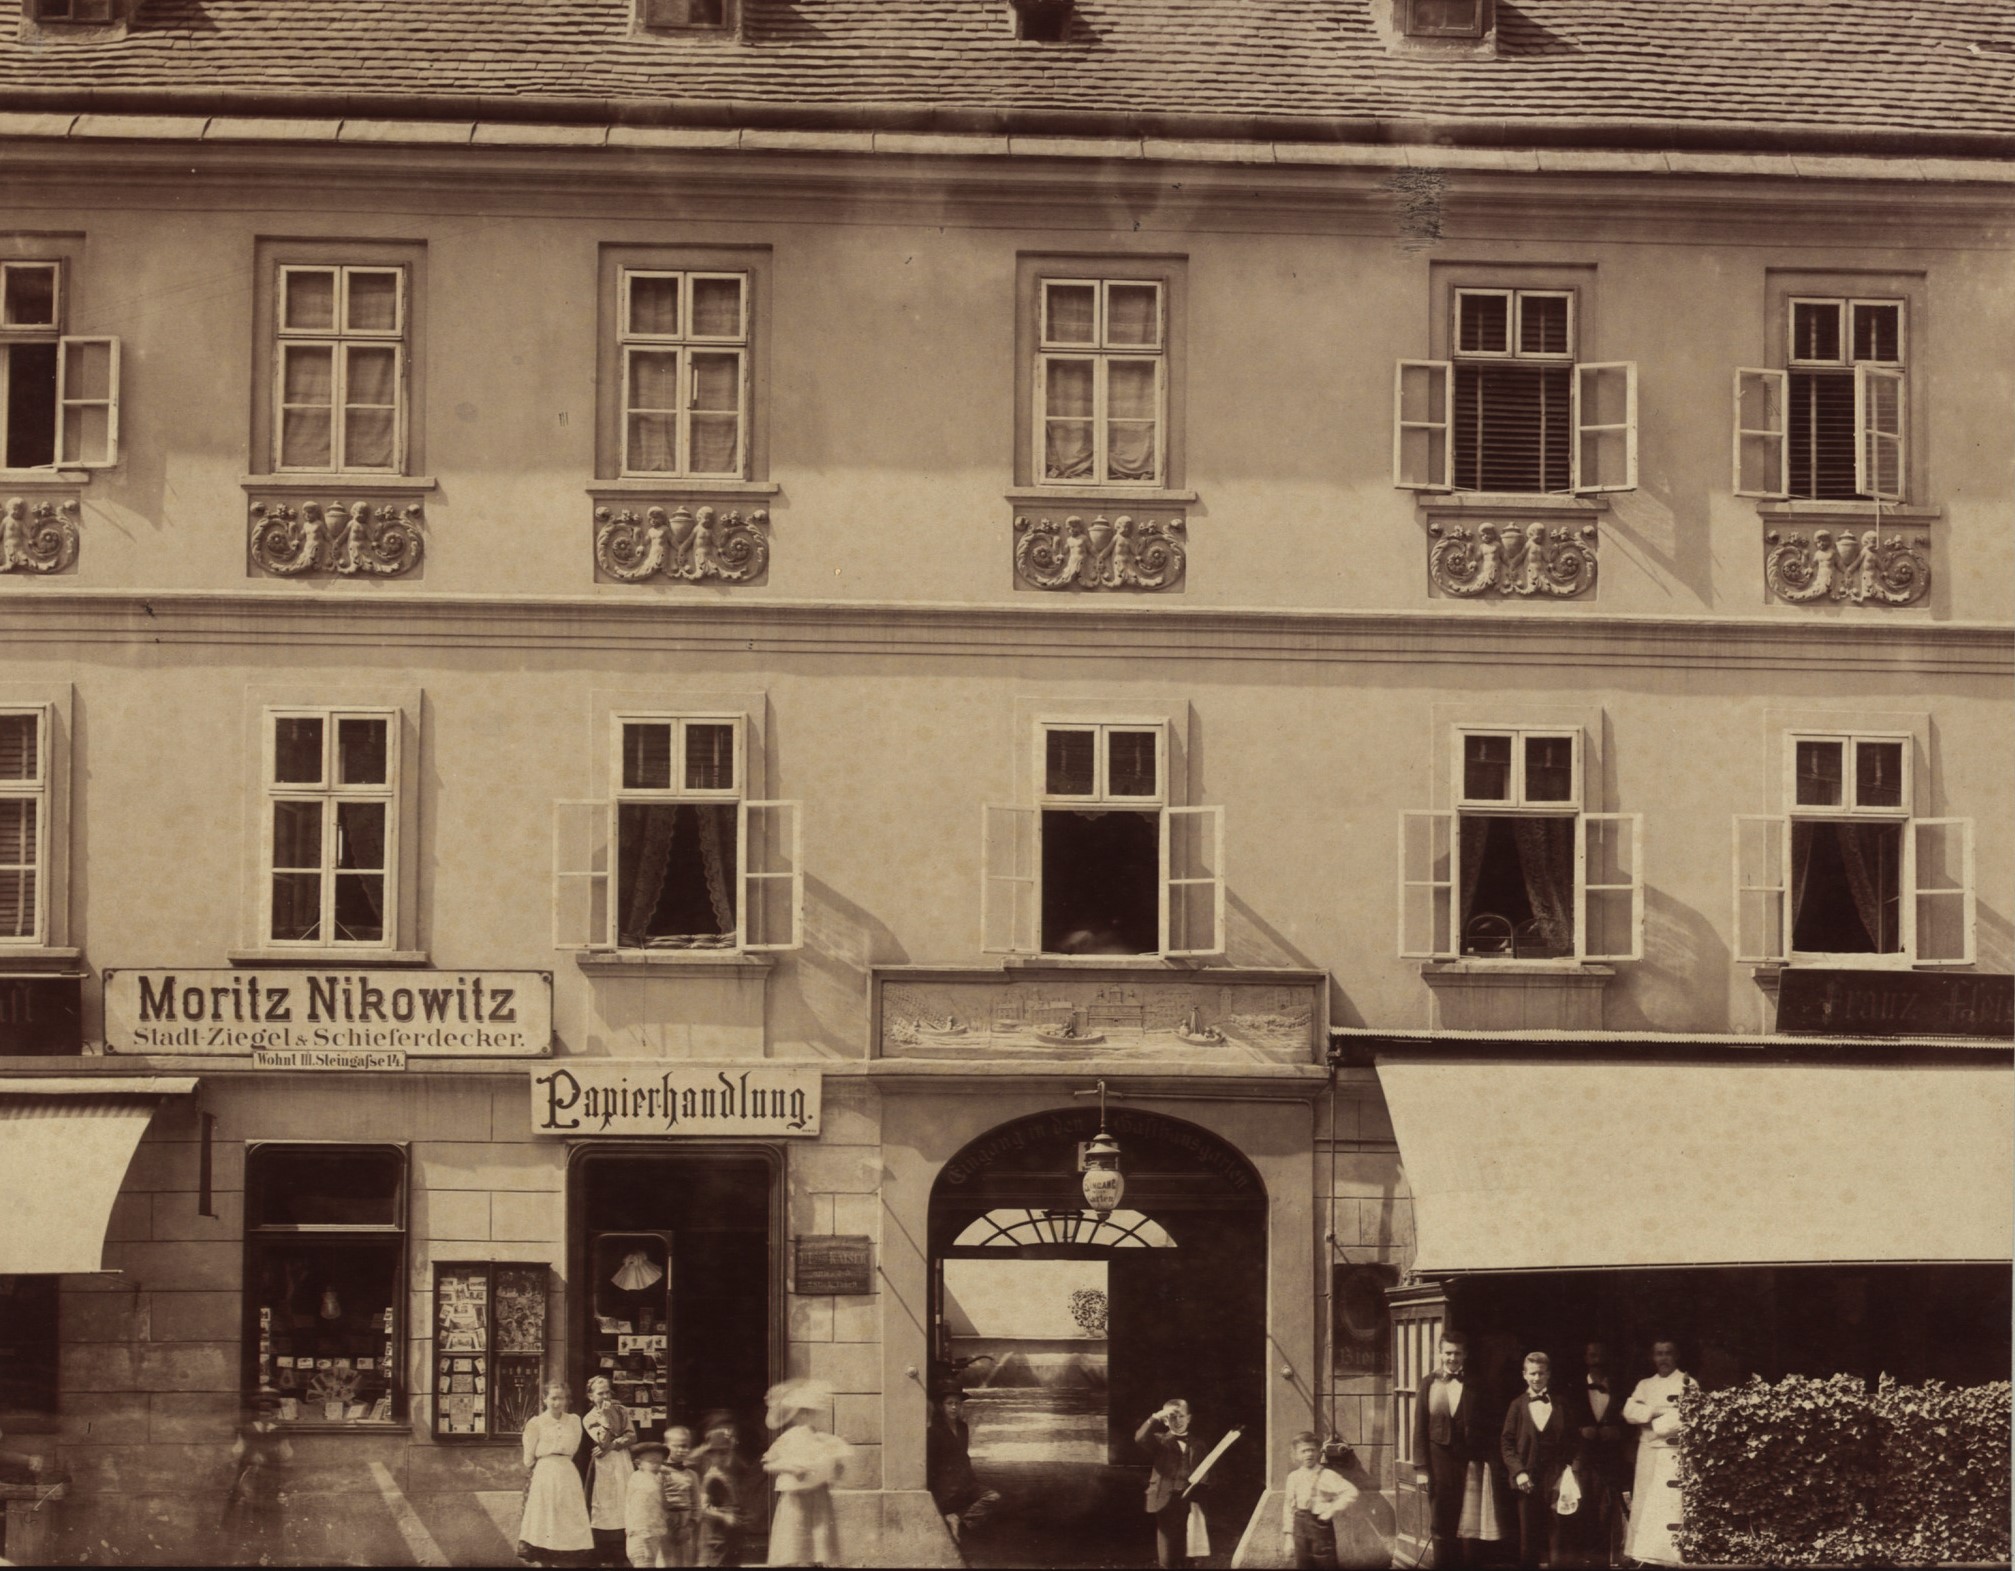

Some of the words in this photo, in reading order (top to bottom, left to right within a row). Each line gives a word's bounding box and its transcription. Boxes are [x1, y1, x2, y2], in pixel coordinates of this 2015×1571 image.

[138, 975, 292, 1022] Moritz
[306, 976, 517, 1022] Nikowitz
[295, 1033, 309, 1047] &
[313, 1027, 525, 1047] Schieferdecker.
[257, 1052, 296, 1066] Wohnt
[536, 1068, 814, 1131] Papierhandlung.
